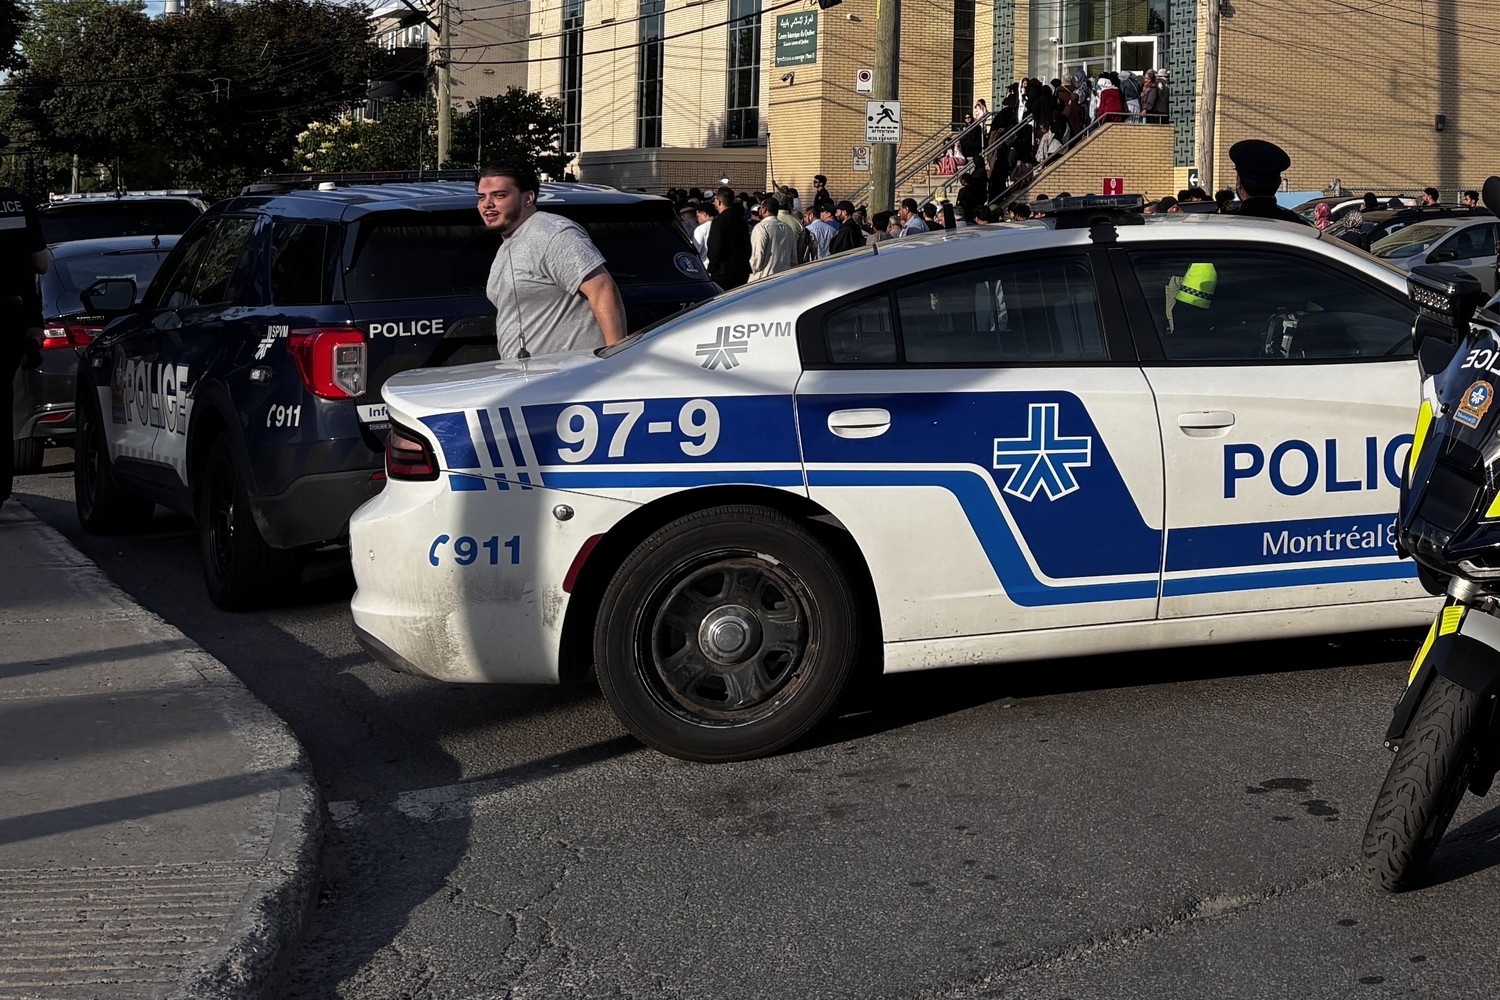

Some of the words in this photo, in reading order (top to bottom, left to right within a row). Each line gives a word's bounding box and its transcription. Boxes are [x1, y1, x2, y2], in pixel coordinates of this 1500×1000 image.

[0, 201, 24, 212] ICE
[272, 325, 289, 338] SPVM
[369, 319, 444, 339] POLICE
[732, 322, 791, 339] SPVM
[125, 359, 190, 436] POLICE
[276, 405, 301, 427] 911
[557, 399, 720, 463] 97-9
[1224, 434, 1415, 498] POLIC
[454, 536, 520, 566] 911
[1263, 523, 1382, 556] Montréal
